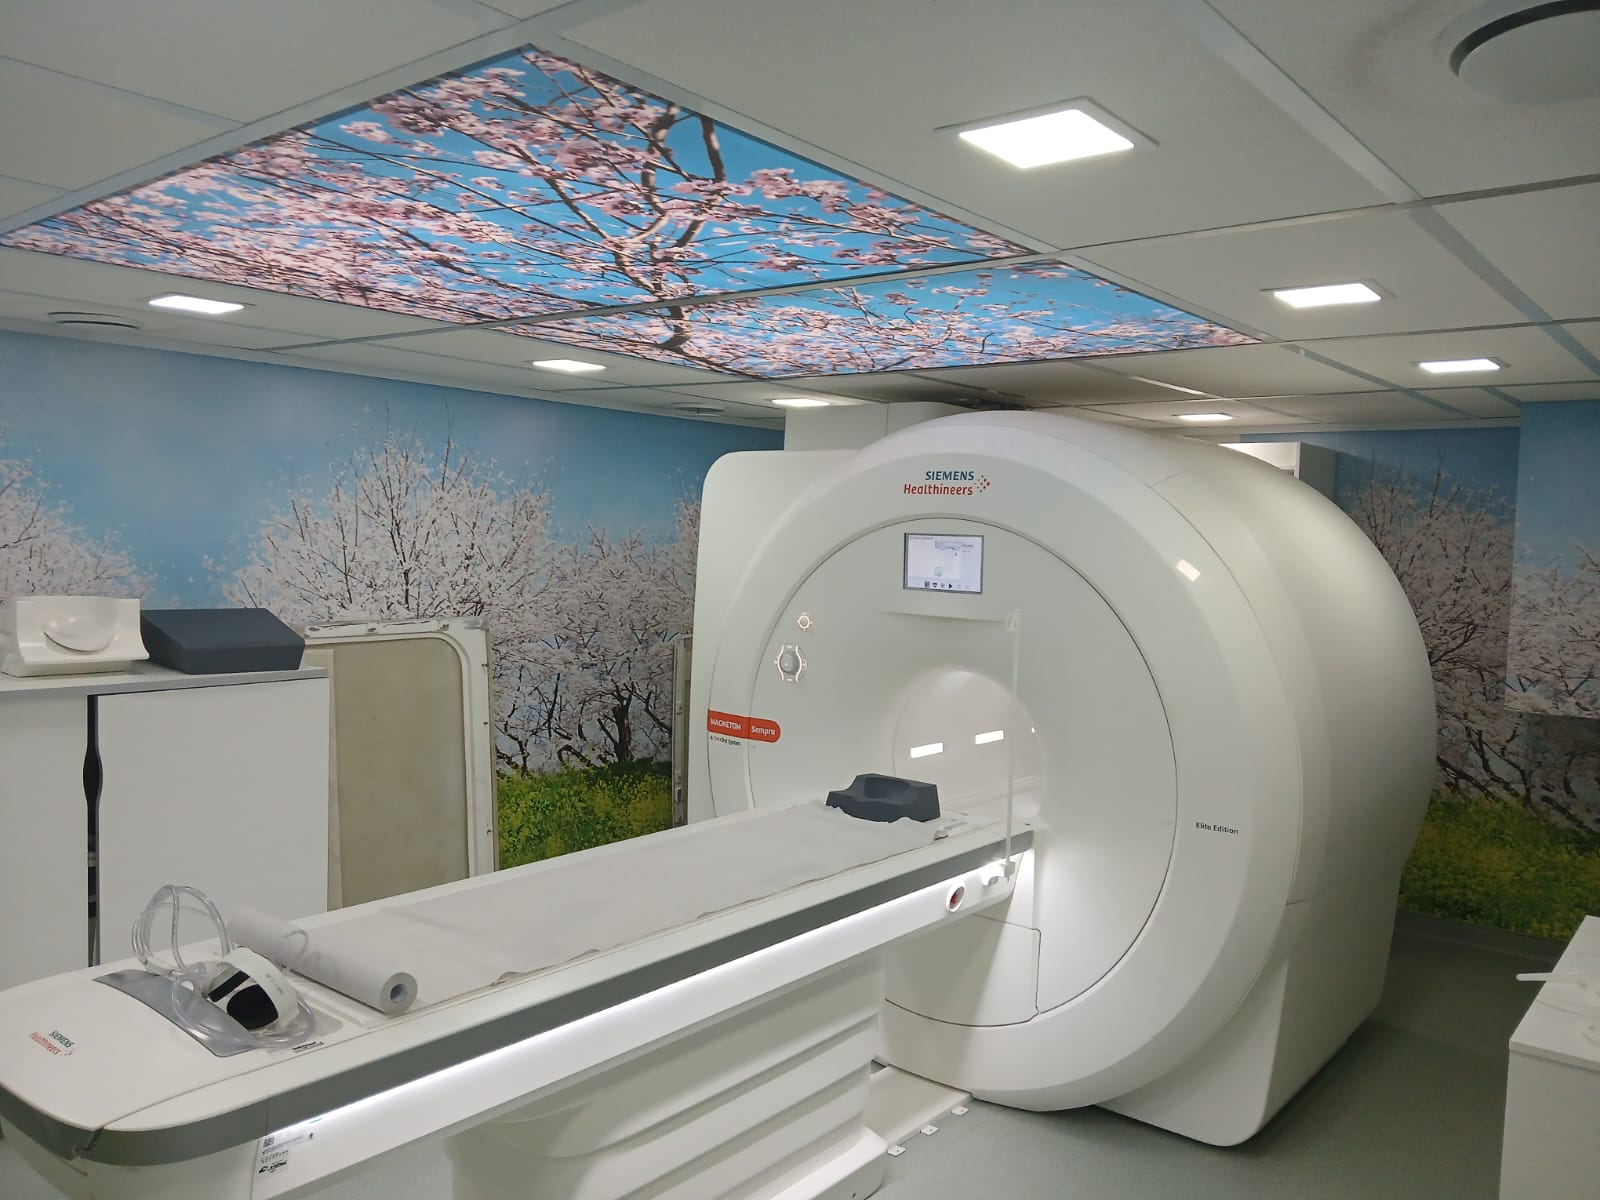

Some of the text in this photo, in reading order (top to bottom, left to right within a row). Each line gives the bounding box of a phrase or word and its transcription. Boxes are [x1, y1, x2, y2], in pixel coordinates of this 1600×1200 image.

[925, 470, 975, 481] SIEMENS
[903, 483, 973, 496] Healthineers
[710, 717, 742, 730] MAGNETOM
[1195, 821, 1239, 834] Elite Edition
